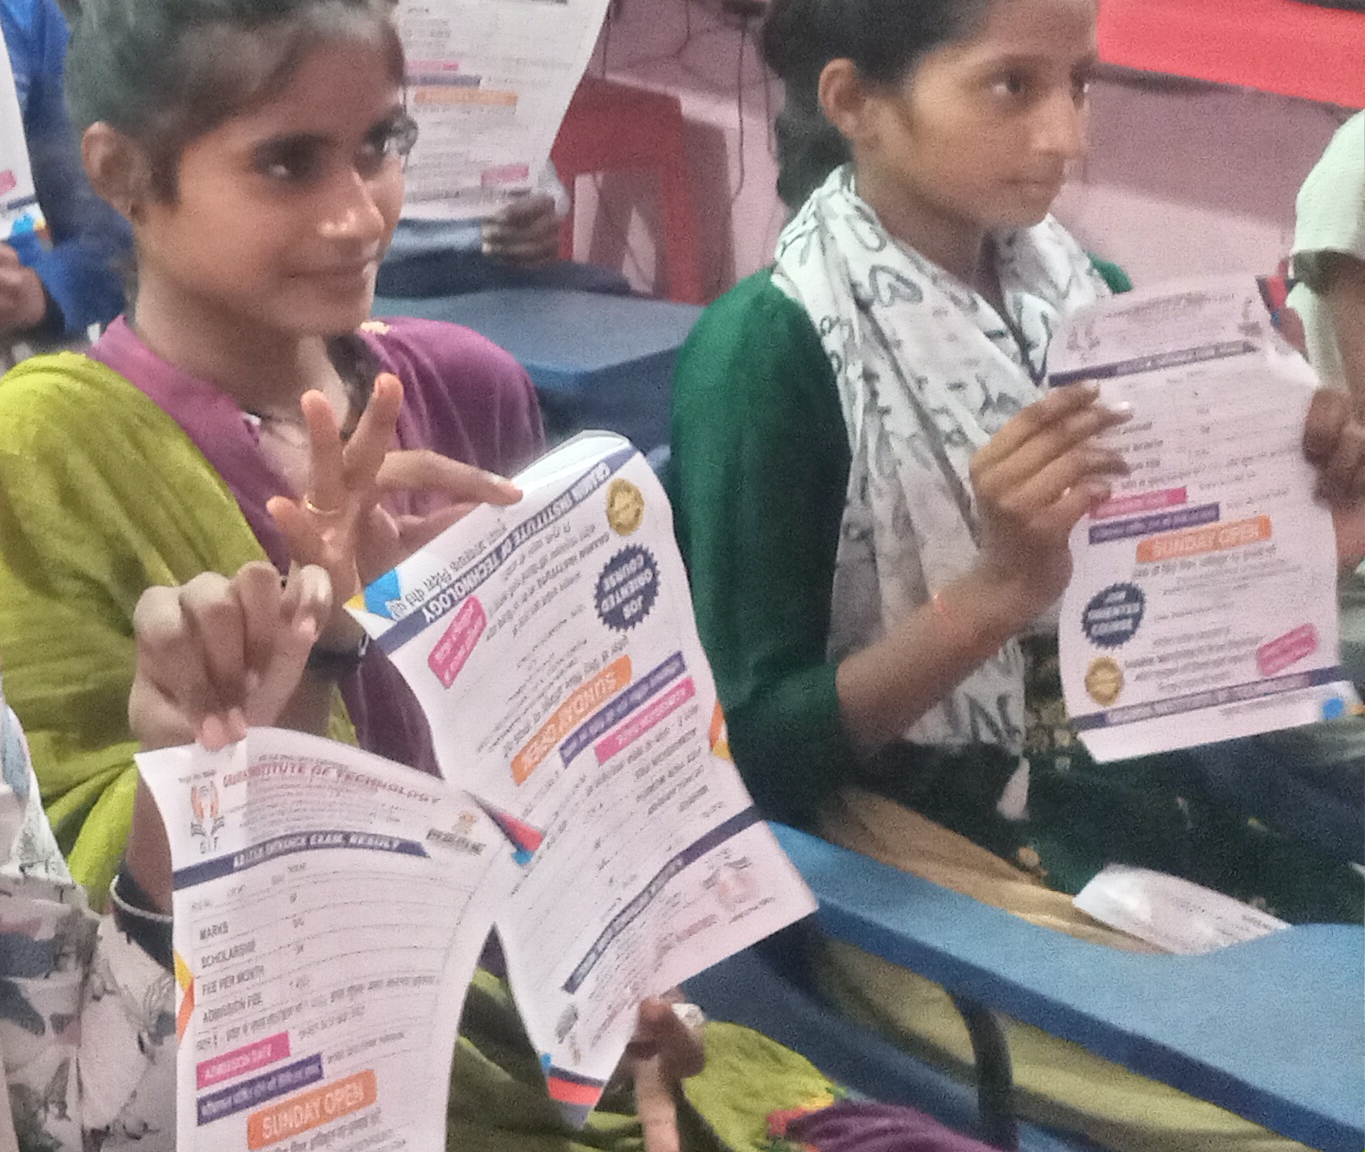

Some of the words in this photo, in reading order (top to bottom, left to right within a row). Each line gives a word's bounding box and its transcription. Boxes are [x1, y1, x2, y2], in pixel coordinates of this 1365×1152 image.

[516, 491, 575, 543] INSTITUTE
[420, 551, 502, 623] TECHNOLOGY
[598, 554, 645, 591] COURSE
[598, 567, 654, 613] ORIENTED
[618, 595, 647, 619] JOB
[556, 671, 618, 731] SUNDAY
[200, 980, 219, 995] FEE
[217, 974, 236, 989] PER
[262, 1102, 319, 1139] SUNDAY
[324, 1084, 365, 1114] OPEN
